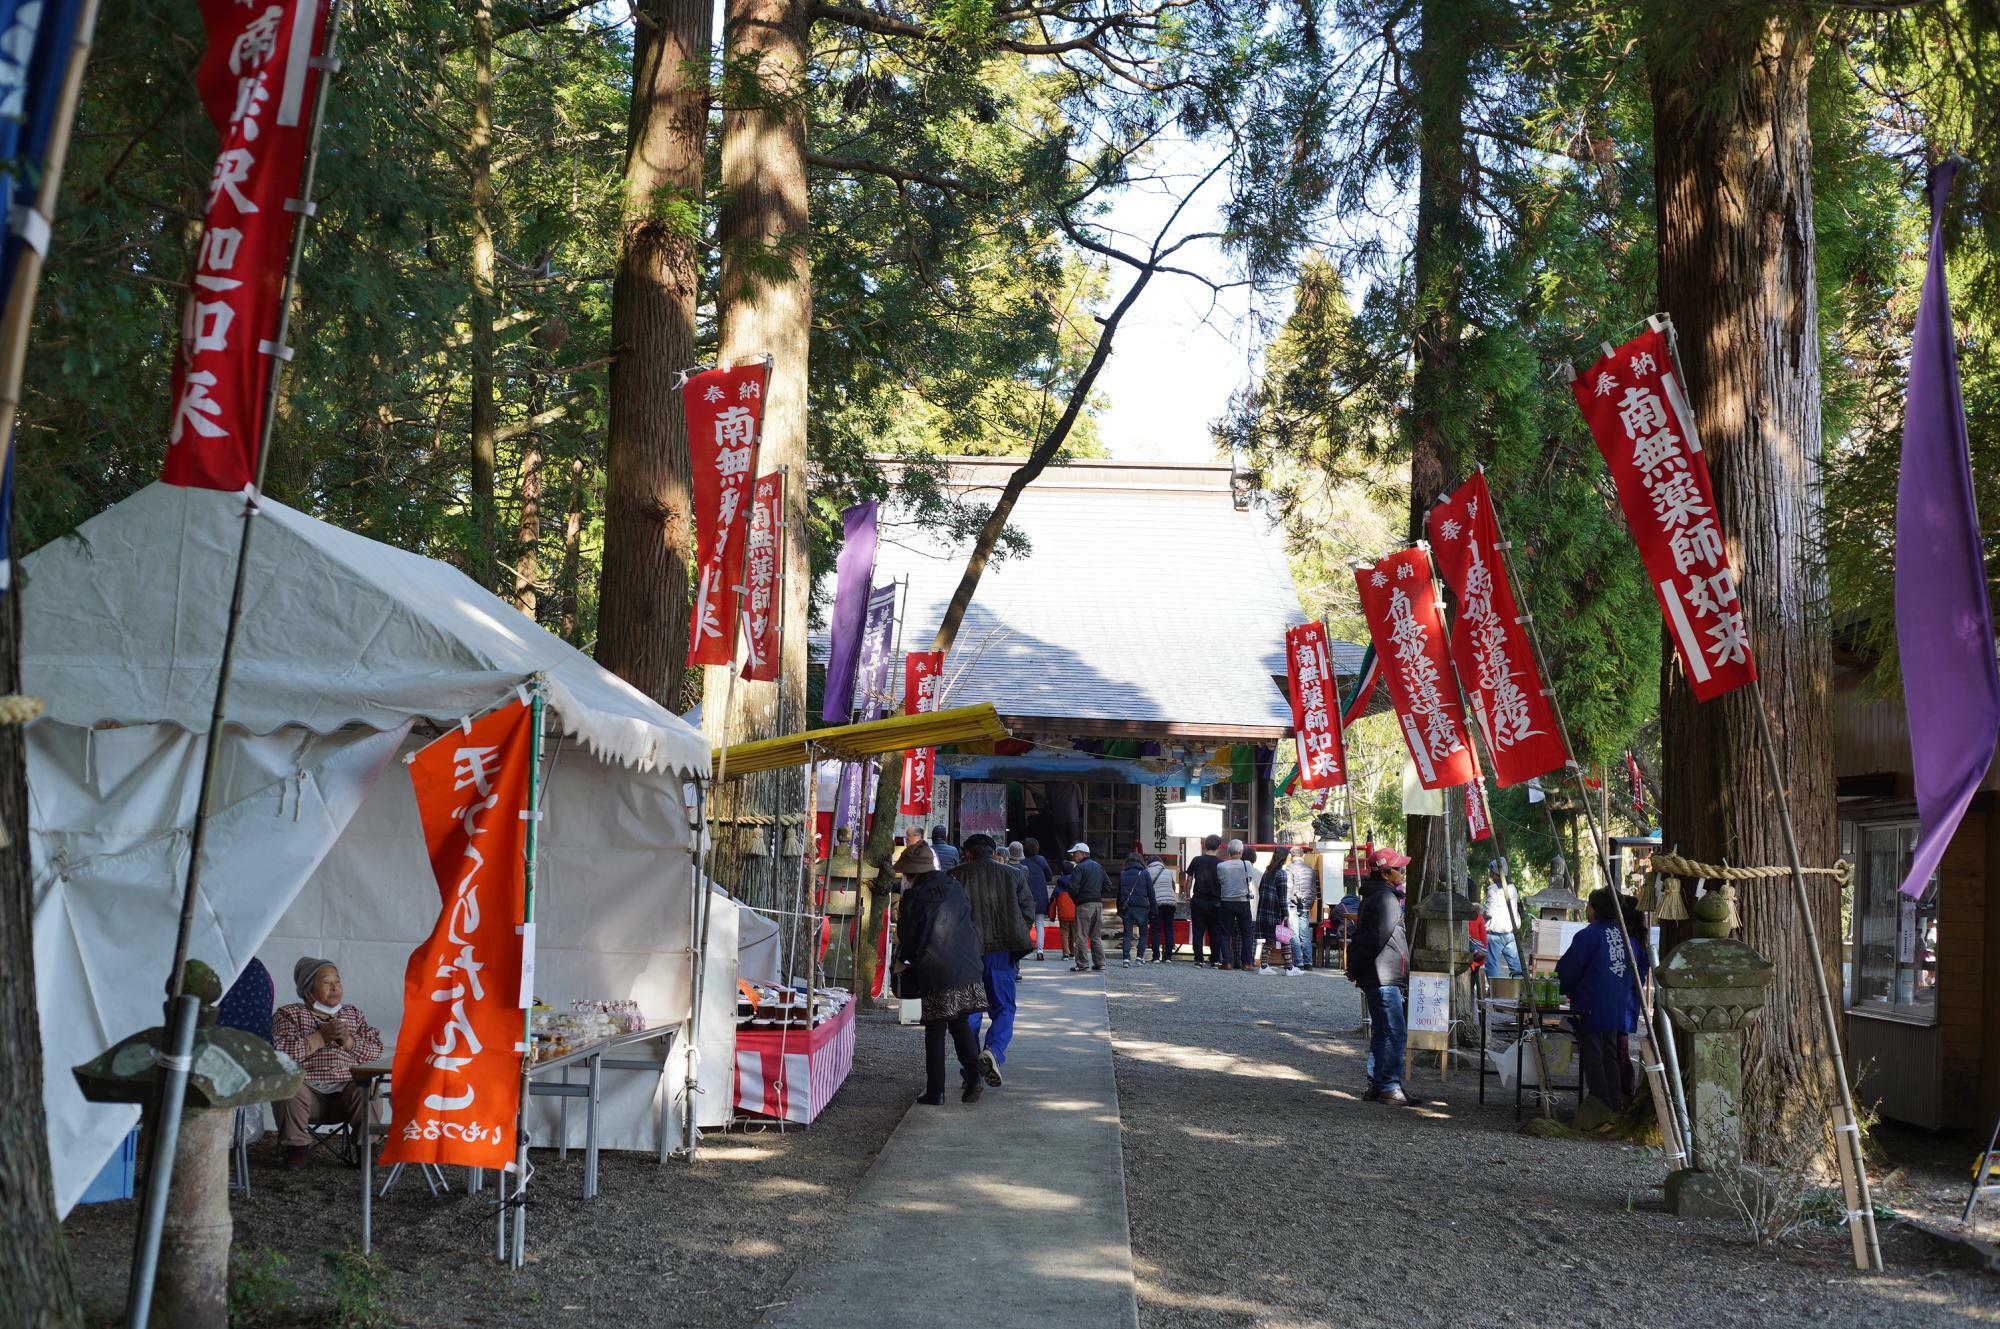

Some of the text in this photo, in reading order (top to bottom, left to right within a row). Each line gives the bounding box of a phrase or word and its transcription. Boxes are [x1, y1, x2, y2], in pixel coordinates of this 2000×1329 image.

[702, 380, 761, 404] 奉納
[1594, 351, 1657, 398] 奉納
[1616, 386, 1750, 669] 南無薬師如来
[1371, 563, 1415, 589] 奉納
[1295, 644, 1341, 778] 南無薬師如来
